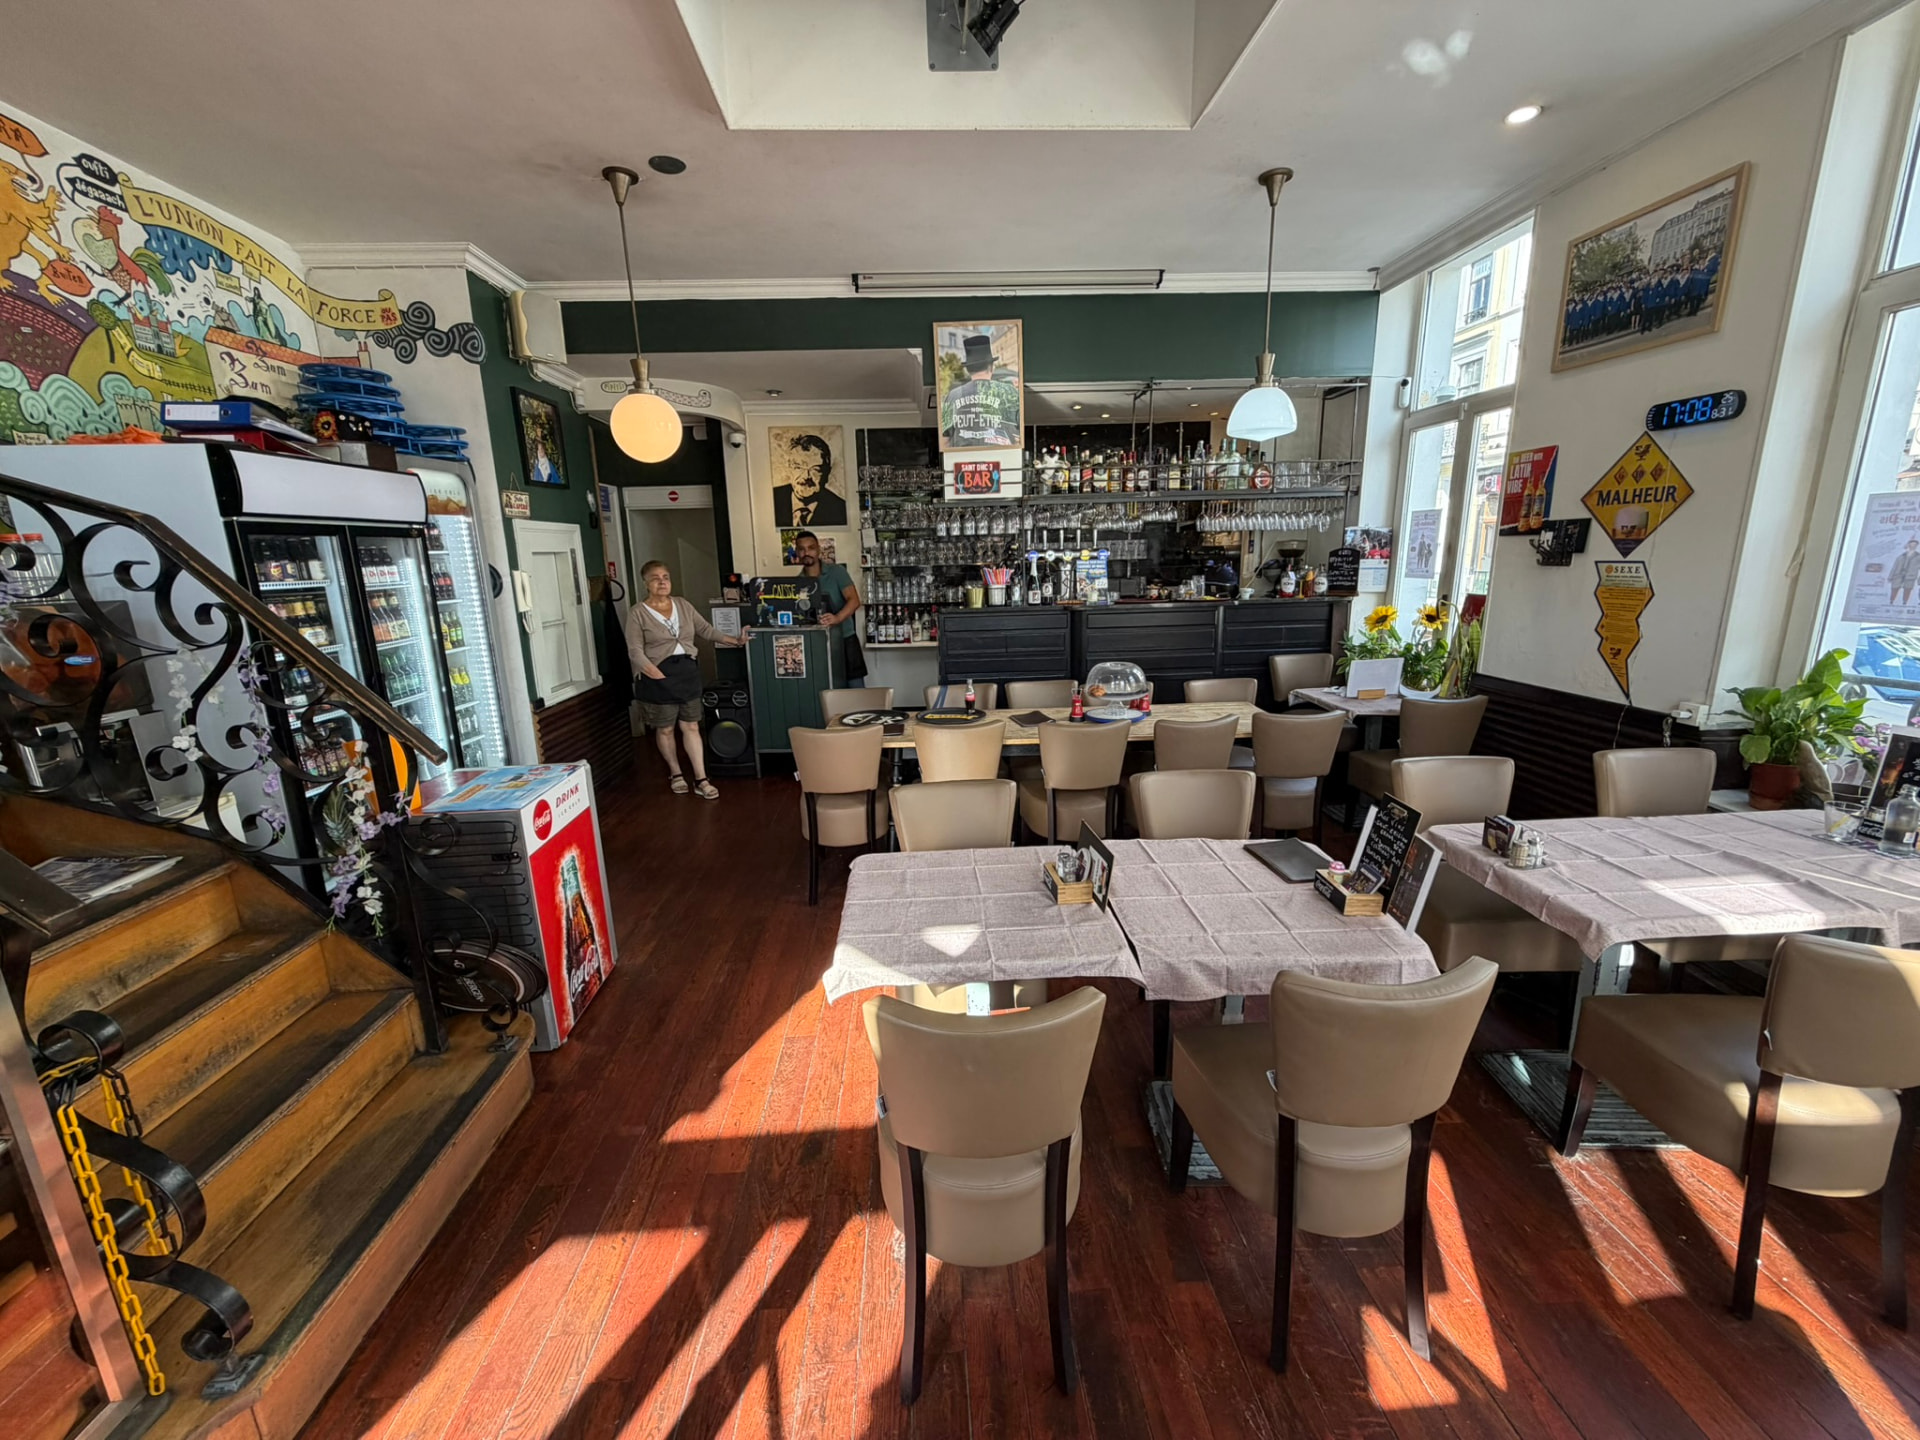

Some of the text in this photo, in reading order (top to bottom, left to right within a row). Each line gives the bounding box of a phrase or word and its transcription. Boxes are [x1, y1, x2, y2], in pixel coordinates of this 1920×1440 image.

[234, 239, 276, 274] FAIT
[286, 277, 305, 304] LA
[315, 301, 376, 324] FORCE
[380, 312, 398, 323] PAS
[1662, 396, 1713, 426] 17:08
[964, 472, 992, 488] BAR
[1596, 485, 1678, 507] MALHEUR
[1614, 565, 1641, 574] SEXE
[556, 782, 579, 808] DRINK
